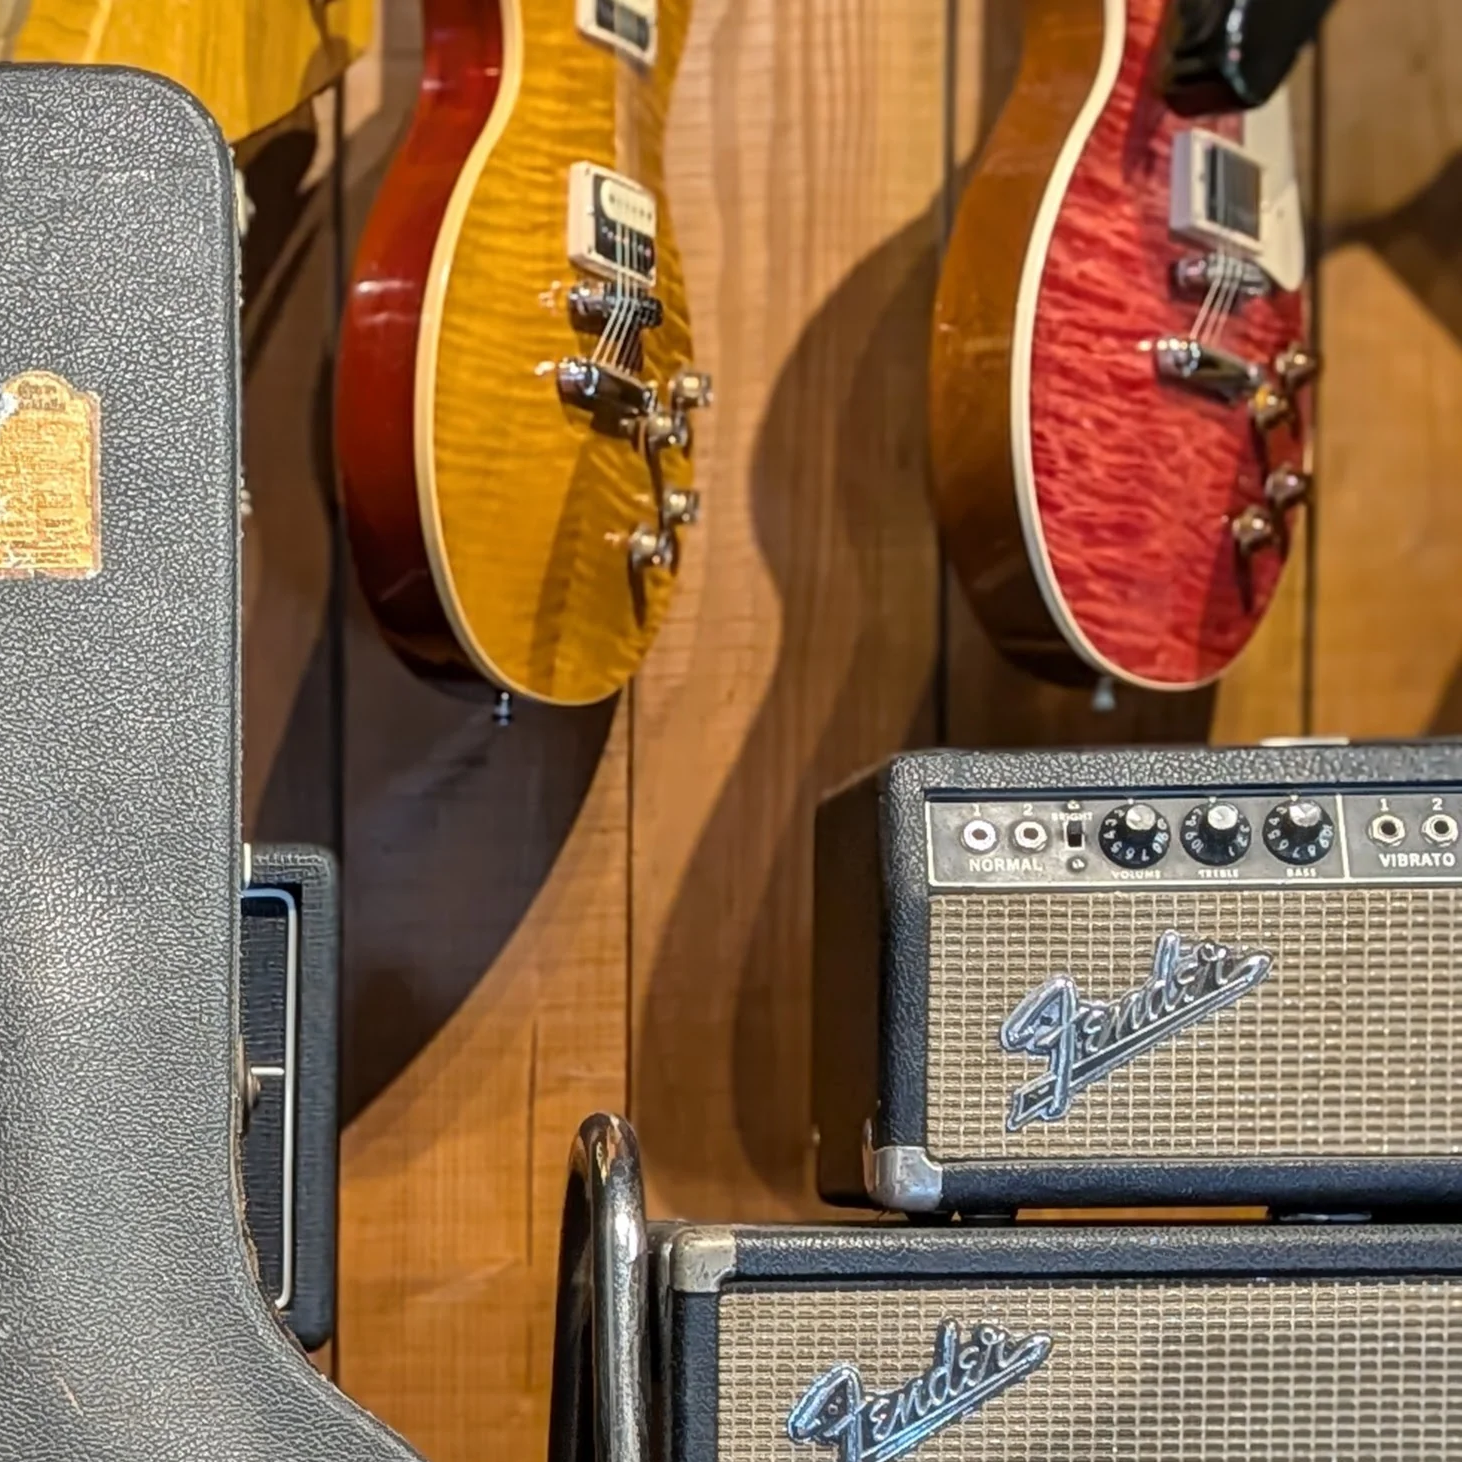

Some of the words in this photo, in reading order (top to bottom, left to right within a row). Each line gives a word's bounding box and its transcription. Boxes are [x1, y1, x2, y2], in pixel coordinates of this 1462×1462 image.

[972, 803, 981, 816] 1
[1023, 803, 1033, 816] 2
[1380, 798, 1389, 811] 1
[1432, 798, 1443, 811] 2
[969, 858, 1043, 872] NORMAL
[1379, 853, 1456, 867] VIBRATO
[1111, 870, 1162, 879] VOLUME
[1198, 869, 1239, 878] TREBLE
[1286, 868, 1317, 877] BASS
[999, 929, 1274, 1132] Fender
